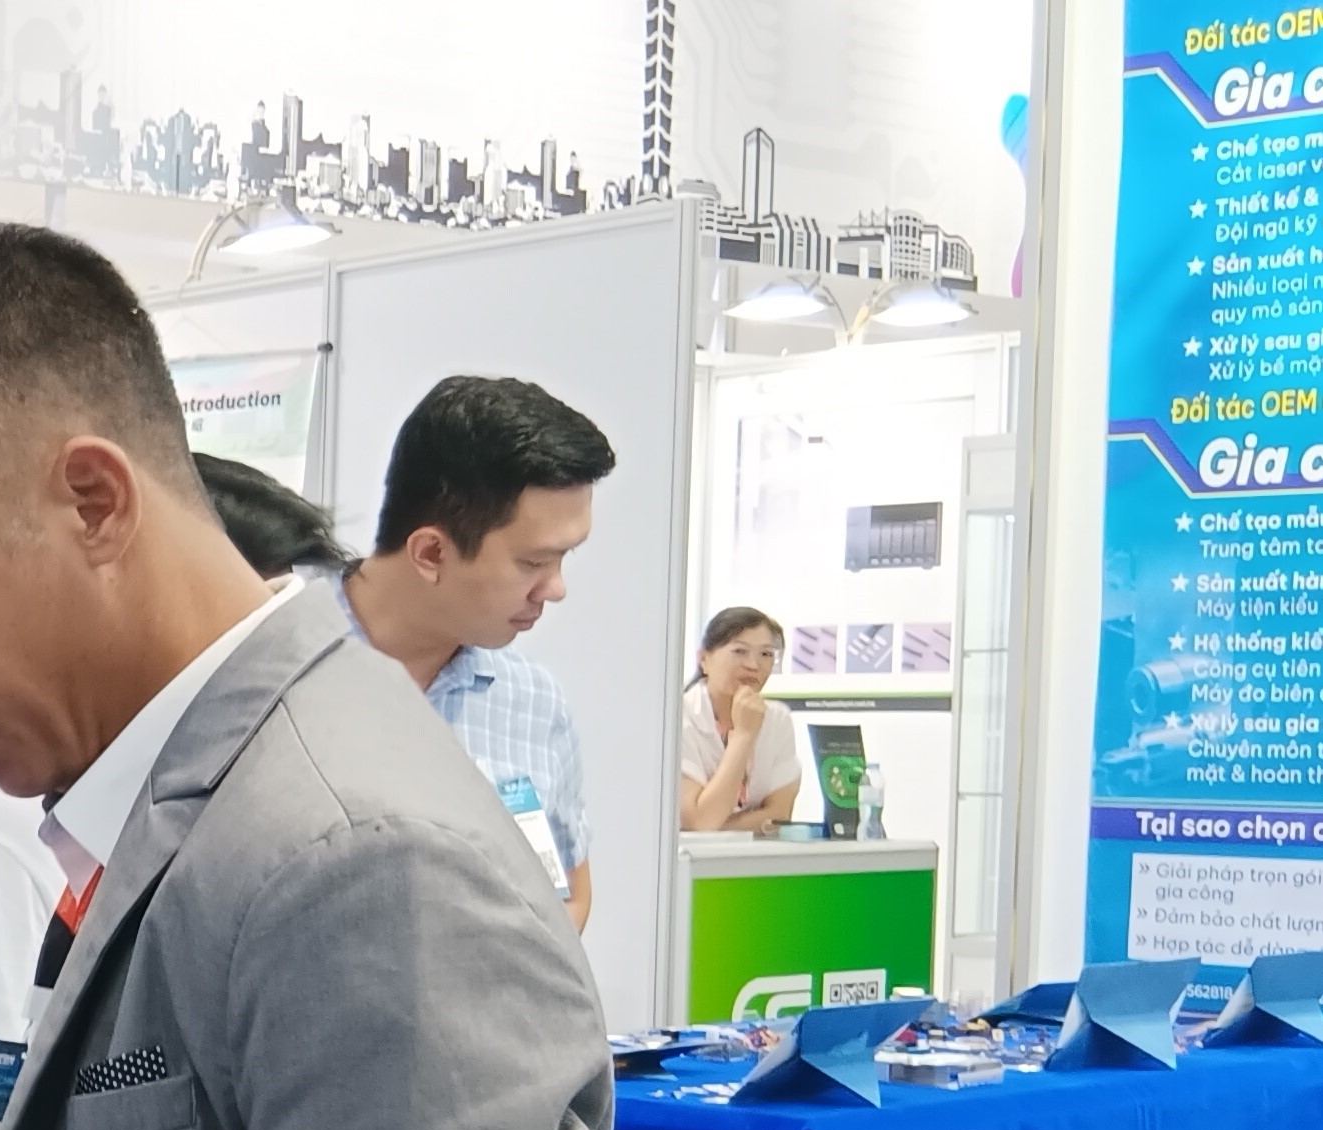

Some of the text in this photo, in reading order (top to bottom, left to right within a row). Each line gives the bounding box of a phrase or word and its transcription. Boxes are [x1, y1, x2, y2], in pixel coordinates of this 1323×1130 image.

[1185, 19, 1225, 56] Đối
[1231, 18, 1270, 48] tác
[1214, 61, 1294, 116] Gia
[1216, 133, 1259, 160] Chế
[1263, 136, 1300, 157] tạo
[1258, 160, 1306, 180] laser
[1215, 186, 1319, 217] Thiết kế &
[1216, 214, 1317, 245] Đội ngũ kỹ
[1212, 252, 1252, 275] Sản
[1257, 245, 1304, 270] xuất
[1212, 273, 1308, 300] Nhiều loại
[1211, 299, 1282, 327] quy mô
[1209, 334, 1302, 356] Xử sau
[1209, 360, 1236, 381] Xử
[182, 390, 282, 413] ntroduction
[1171, 387, 1317, 424] Đối tác OEM
[1199, 433, 1289, 488] Gia
[1200, 509, 1282, 535] Chế tạo
[1200, 539, 1254, 561] Trung
[1260, 536, 1300, 556] tâm
[1197, 568, 1288, 592] Sản xuất
[1197, 597, 1276, 621] Máy tiện
[1194, 629, 1287, 656] Hệ thống
[1193, 659, 1276, 682] Công cụ
[1191, 683, 1266, 705] Máy đo
[1243, 713, 1319, 736] sau gia
[1188, 738, 1312, 761] Chuyên môn
[1187, 762, 1225, 786] mặt
[1231, 764, 1245, 783] &
[1251, 764, 1302, 784] hoàn
[1136, 811, 1176, 841] Tại
[1182, 818, 1231, 838] sao
[1237, 815, 1306, 846] chọn
[1156, 862, 1323, 887] Giải pháp trọn gói
[1155, 885, 1234, 904] gia công
[1154, 907, 1281, 930] Đảm bảo chất
[1153, 936, 1225, 955] Hợp tác
